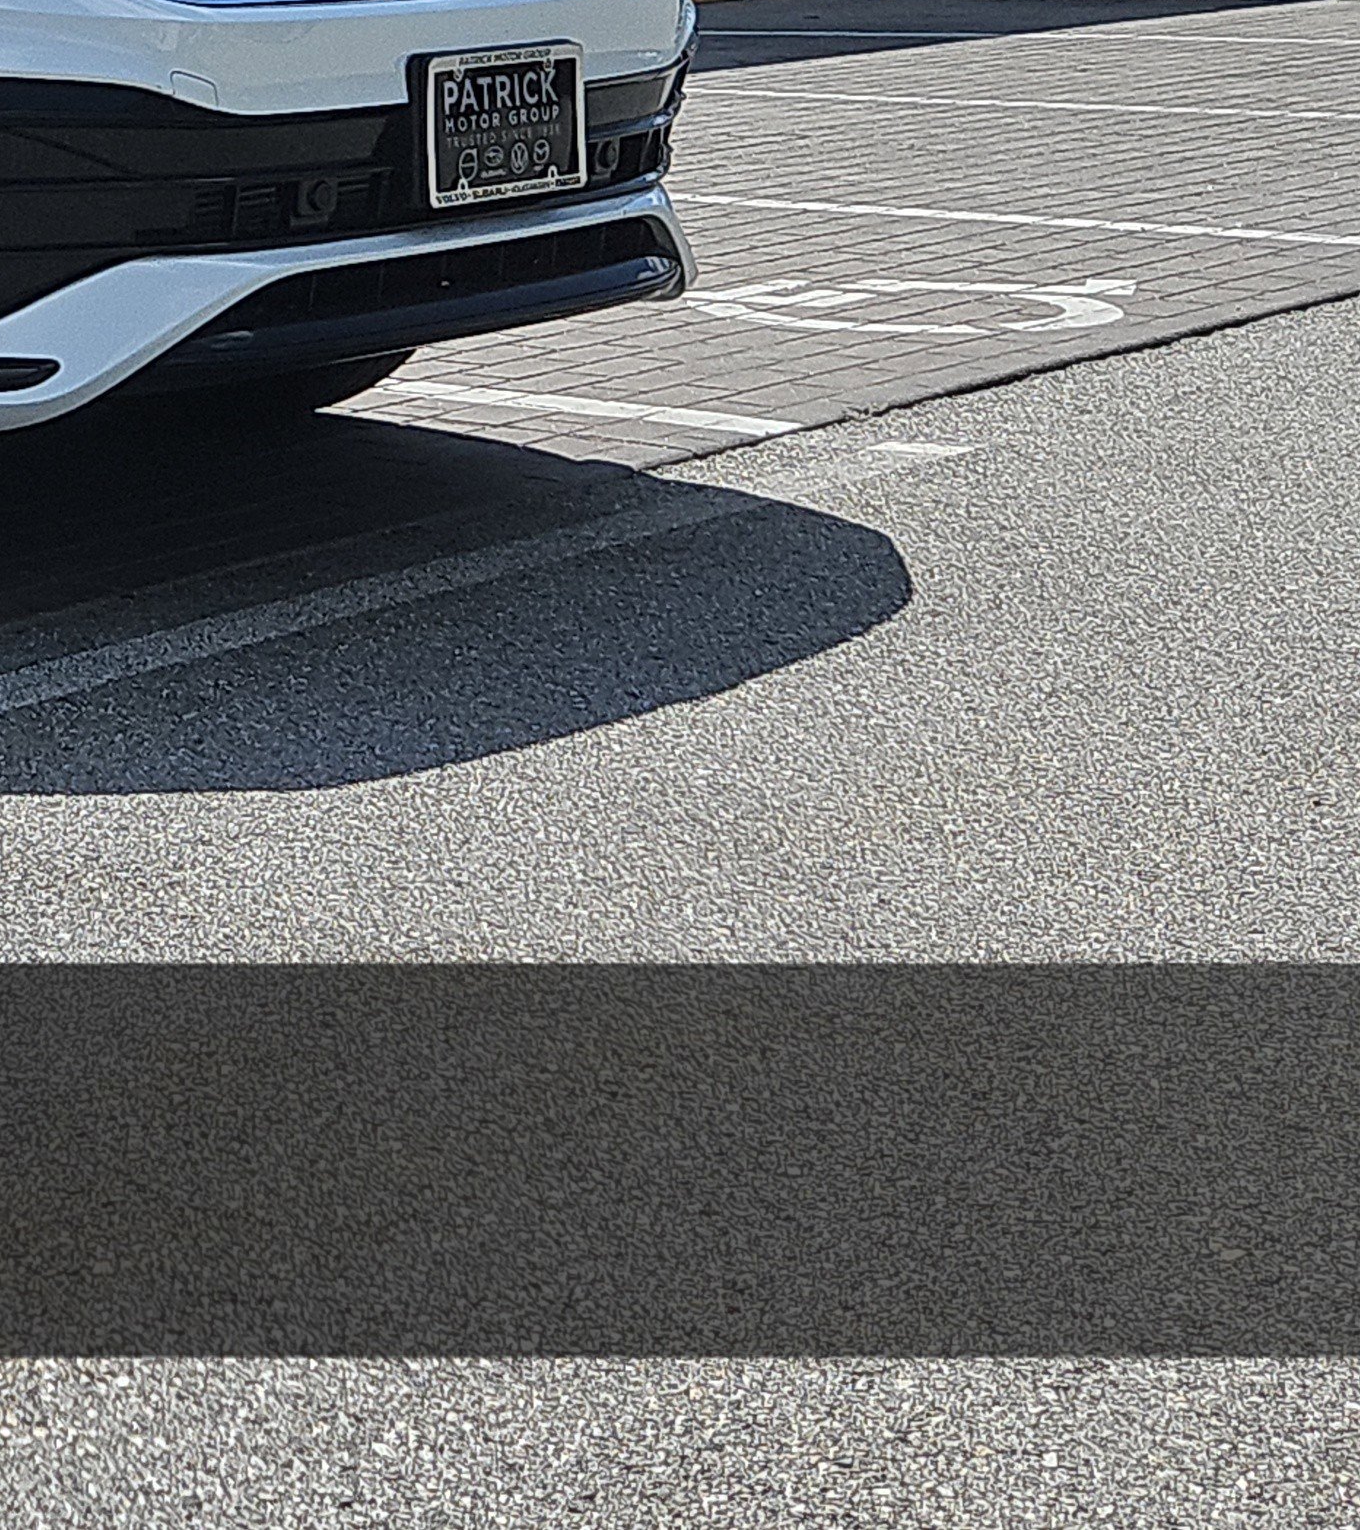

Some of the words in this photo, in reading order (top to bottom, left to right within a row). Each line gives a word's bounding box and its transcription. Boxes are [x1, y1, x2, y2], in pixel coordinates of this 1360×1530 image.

[443, 70, 559, 115] PATRICK
[445, 111, 500, 134] MOTOR
[508, 104, 560, 126] GROUP
